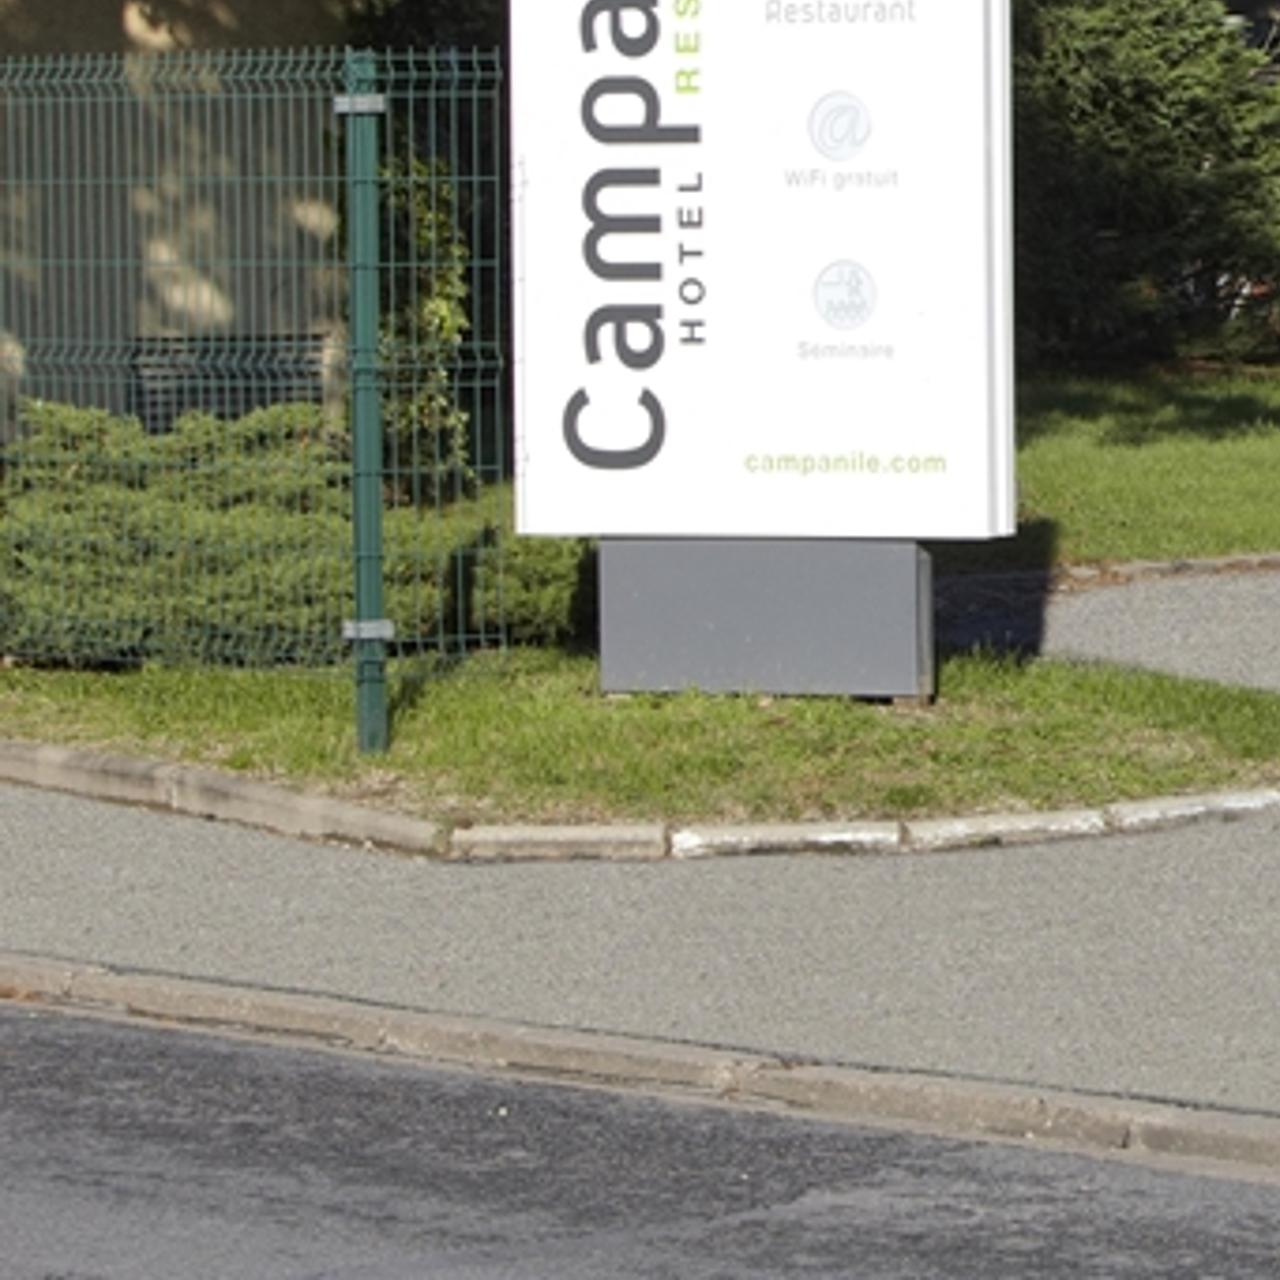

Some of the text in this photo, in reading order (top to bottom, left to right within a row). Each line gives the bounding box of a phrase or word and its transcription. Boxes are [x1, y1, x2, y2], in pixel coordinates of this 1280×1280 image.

[834, 169, 899, 191] gratuit
[677, 172, 706, 346] HOTEL
[744, 451, 946, 476] campanile.com
